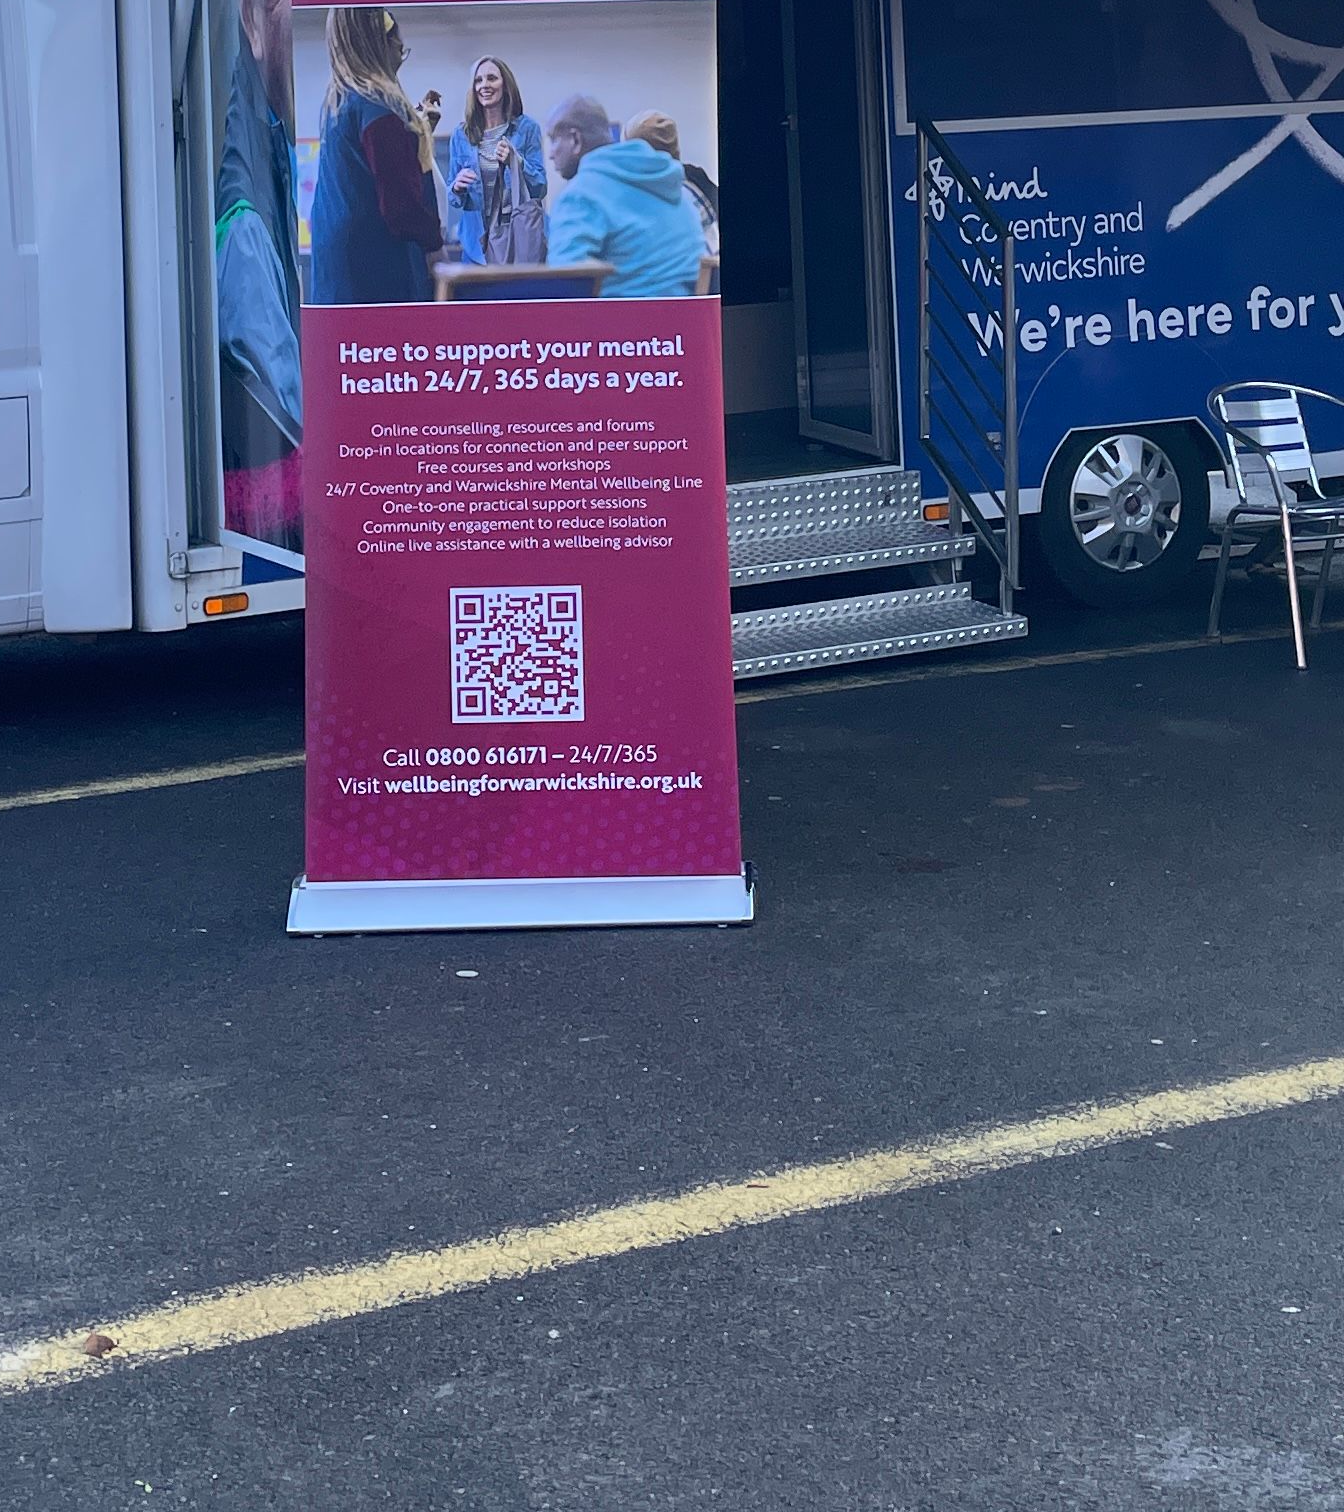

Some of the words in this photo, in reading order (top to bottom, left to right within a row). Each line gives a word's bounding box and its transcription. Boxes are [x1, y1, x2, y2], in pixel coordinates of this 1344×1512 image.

[959, 210, 1087, 247] Coentry
[1094, 200, 1143, 235] and
[1127, 298, 1233, 343] here
[1246, 285, 1315, 331] for
[339, 342, 397, 364] Here
[402, 342, 429, 362] to
[435, 339, 532, 366] support
[535, 341, 592, 364] your
[598, 334, 685, 357] mental
[341, 371, 419, 394] health
[424, 368, 489, 394] 24/7,
[494, 368, 539, 390] 365
[544, 367, 600, 394] days
[605, 372, 620, 388] a
[624, 371, 684, 394] year.
[370, 423, 419, 438] Online
[421, 421, 504, 438] counselling,
[507, 422, 574, 434] resources
[576, 419, 603, 433] and
[606, 418, 655, 432] forums
[339, 444, 392, 460] Drop-in
[395, 442, 460, 456] locations
[462, 440, 483, 454] for
[485, 440, 565, 454] connection
[567, 438, 594, 452] and
[597, 440, 630, 454] peer
[632, 438, 689, 454] support
[417, 460, 448, 474] Free
[450, 462, 504, 474] courses
[506, 459, 533, 473] and
[536, 457, 611, 474] workshops
[325, 482, 357, 497] 24/7
[359, 482, 424, 497] Coventry
[425, 479, 452, 494] and
[455, 478, 547, 493] Warwickshire
[550, 476, 598, 491] Mental
[600, 476, 671, 492] Wellbeing
[674, 475, 703, 489] Line
[382, 500, 465, 514] One-to-one
[469, 497, 529, 515] practical
[531, 497, 587, 513] support
[590, 498, 648, 510] sessions
[362, 520, 446, 535] Community
[448, 517, 535, 534] engagement
[537, 517, 553, 530] to
[556, 515, 605, 529] reduce
[608, 514, 667, 529] isolation
[357, 540, 405, 554] Online
[408, 538, 433, 552] live
[435, 538, 506, 551] assistance
[508, 536, 539, 550] with
[541, 538, 551, 549] a
[553, 534, 622, 551] wellbeing
[624, 534, 673, 548] advisor
[382, 748, 422, 767] Call
[425, 747, 481, 766] 0800
[485, 746, 547, 765] 616171
[569, 743, 657, 765] 24/7/365
[337, 777, 381, 795] Visit
[384, 771, 703, 797] wellbeingforwarwickshire.org.uk
